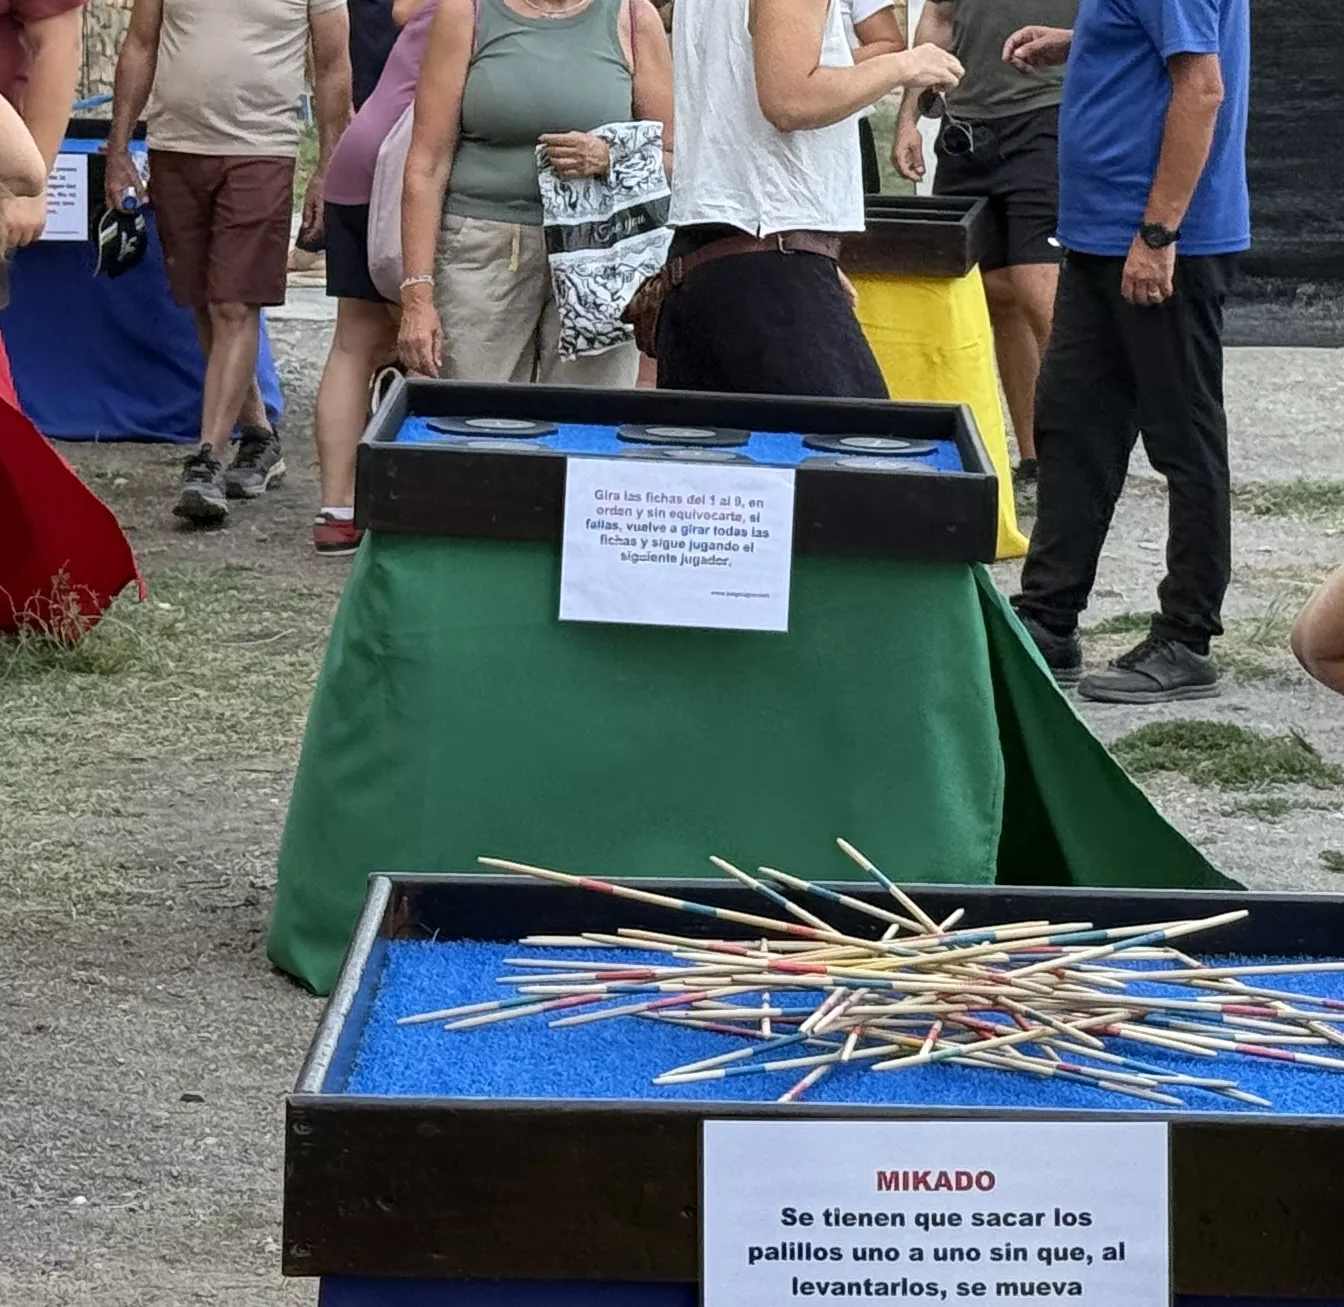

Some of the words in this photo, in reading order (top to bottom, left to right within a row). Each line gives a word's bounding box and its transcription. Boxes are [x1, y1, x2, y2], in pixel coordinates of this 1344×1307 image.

[595, 490, 620, 500] Gira
[624, 491, 641, 502] las
[646, 492, 682, 504] fichas
[687, 495, 705, 504] del
[710, 495, 715, 506] 1
[720, 496, 730, 506] al
[749, 500, 763, 508] en
[596, 505, 632, 516] orden
[636, 509, 643, 520] y
[647, 508, 665, 518] sin
[670, 509, 745, 523] equivocarte,
[750, 513, 760, 522] si
[586, 519, 623, 532] fallas,
[627, 522, 666, 532] vuelve
[670, 525, 677, 533] a
[681, 524, 710, 536] girar
[714, 526, 747, 537] todas
[752, 527, 769, 538] las
[600, 534, 637, 546] fichas
[641, 539, 648, 549] y
[652, 539, 685, 550] sigue
[689, 540, 739, 552] jugando
[743, 542, 754, 552] el
[621, 551, 677, 564] siguiente
[877, 1171, 995, 1191] MIKADO
[781, 1208, 814, 1226] Se
[823, 1208, 905, 1227] tienen
[915, 1213, 962, 1232] que
[972, 1213, 1045, 1227] sacar
[1055, 1208, 1092, 1226] los
[749, 1242, 843, 1265] palillos
[853, 1247, 900, 1261] uno
[909, 1248, 923, 1261] a
[934, 1248, 981, 1261] uno
[990, 1243, 1027, 1261] sin
[1038, 1247, 1092, 1266] que,
[1103, 1242, 1124, 1260] al
[793, 1277, 946, 1300] levantarlos,
[957, 1282, 986, 1296] se
[996, 1282, 1082, 1296] mueva
